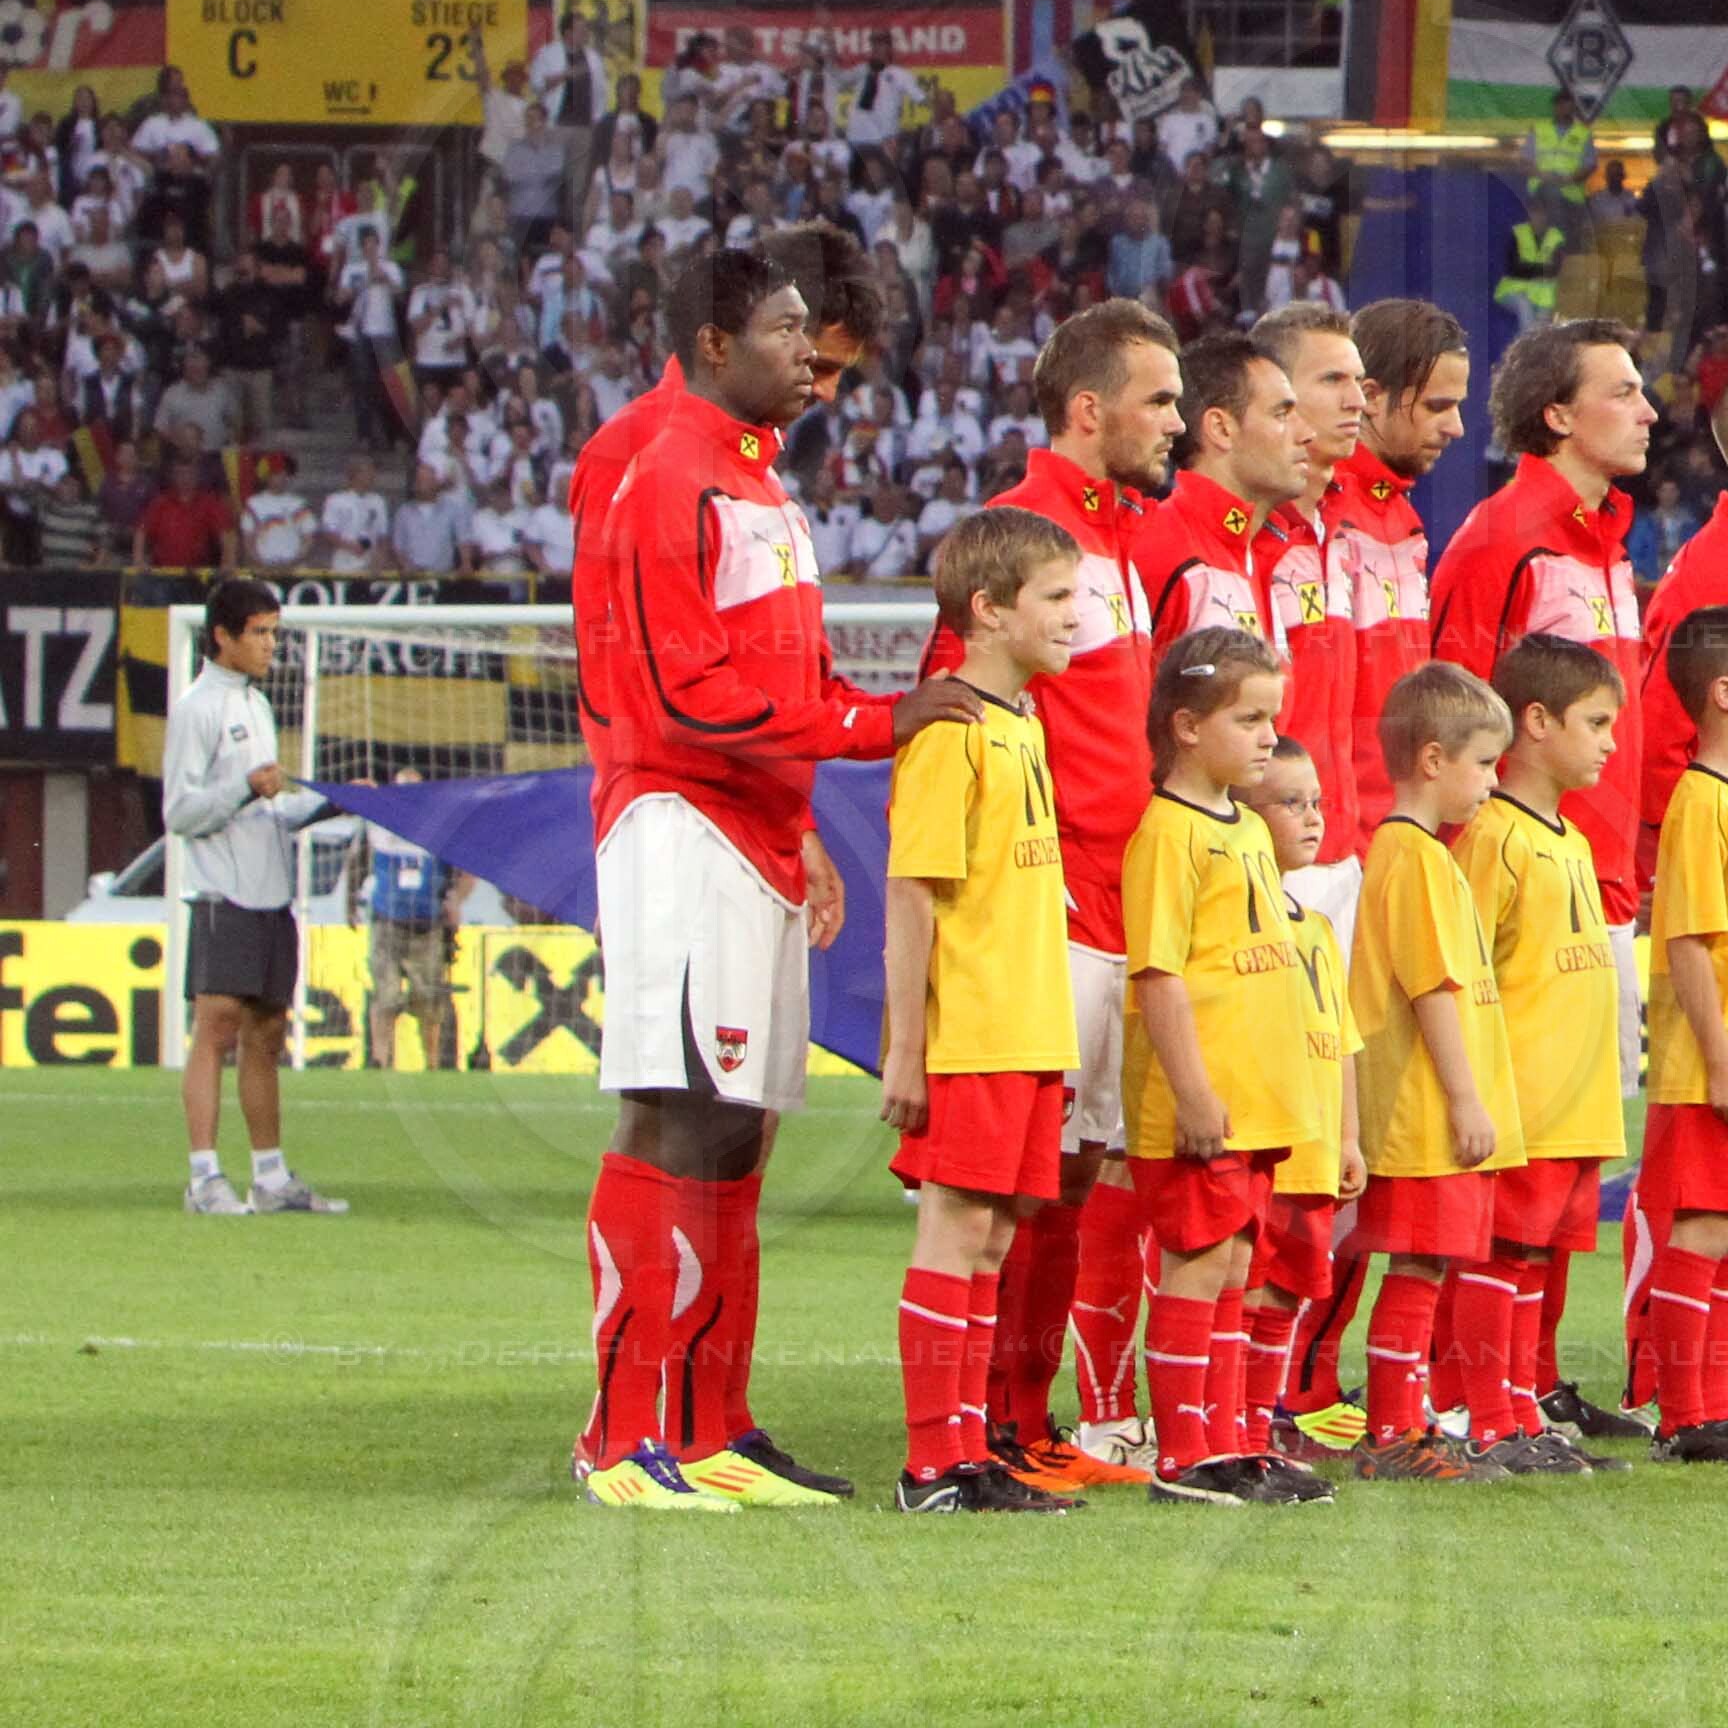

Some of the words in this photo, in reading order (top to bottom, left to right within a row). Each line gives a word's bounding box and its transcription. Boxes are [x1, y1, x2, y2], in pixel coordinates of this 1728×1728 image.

[411, 0, 499, 27] STIEGE
[228, 29, 258, 79] C
[322, 80, 359, 103] WC
